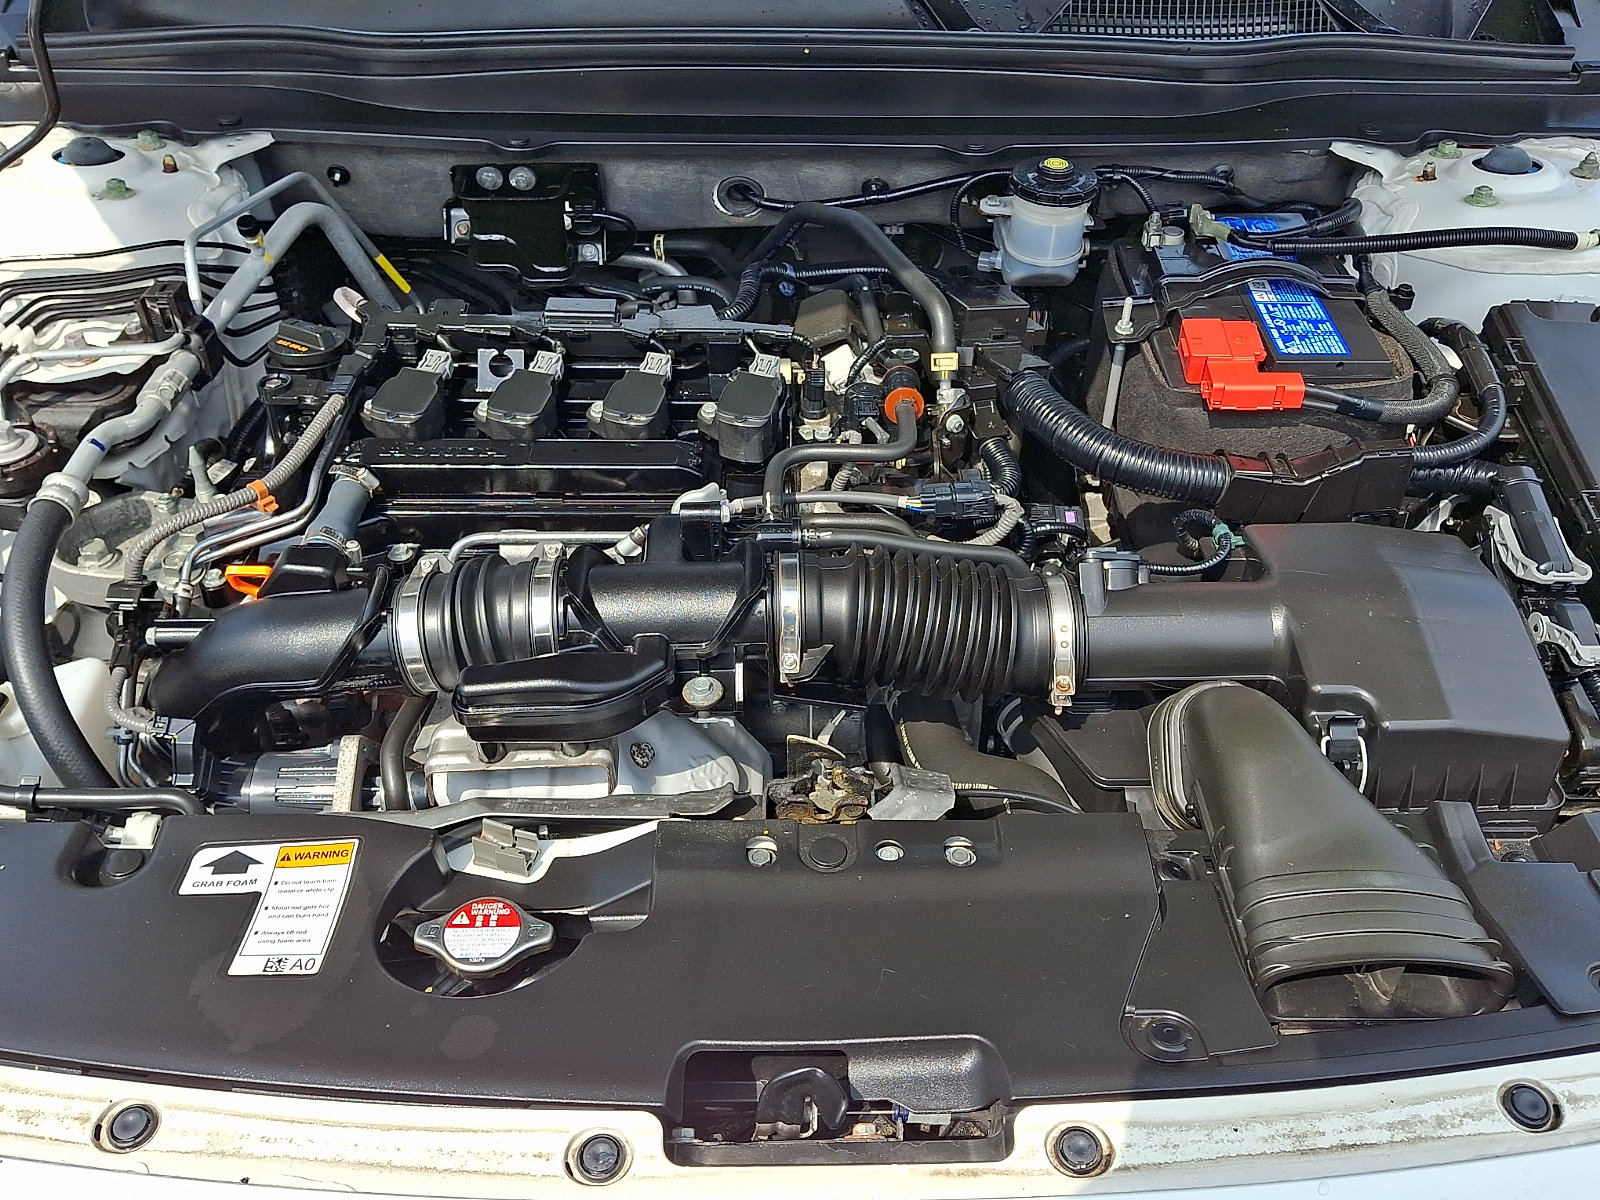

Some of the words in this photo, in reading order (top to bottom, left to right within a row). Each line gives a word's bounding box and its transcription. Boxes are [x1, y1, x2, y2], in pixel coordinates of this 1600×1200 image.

[294, 849, 349, 861] WARNING
[192, 880, 224, 888] GRAB
[226, 878, 258, 887] FOAM
[289, 957, 316, 971] A0
